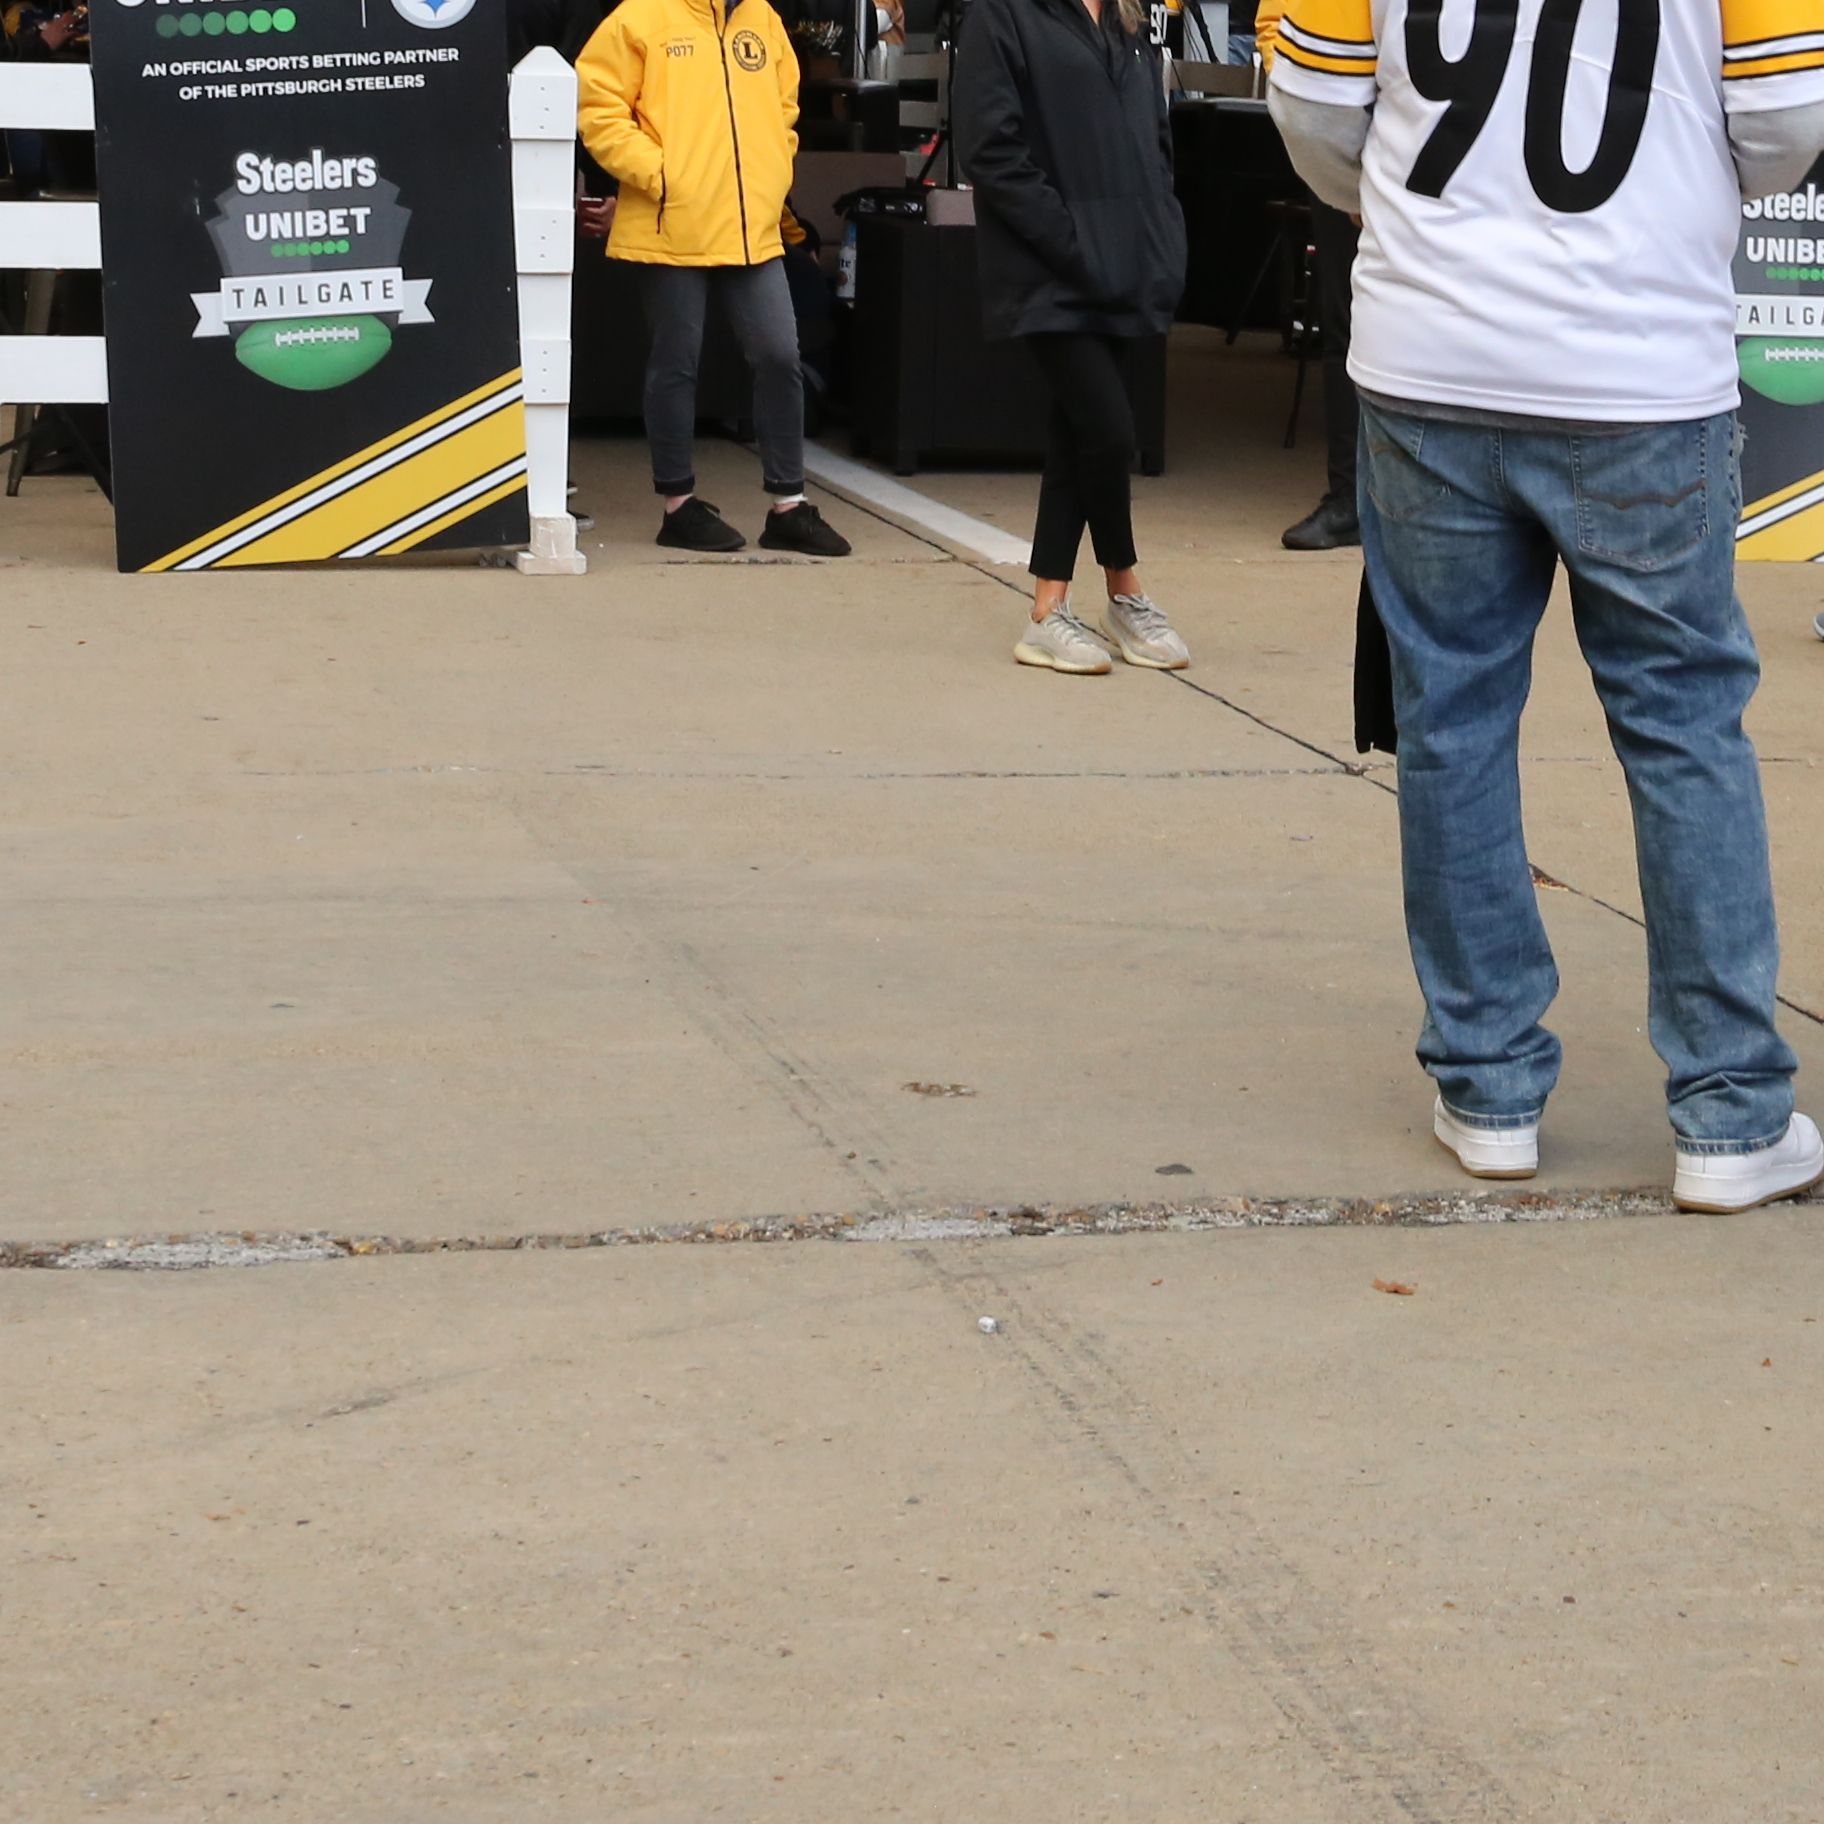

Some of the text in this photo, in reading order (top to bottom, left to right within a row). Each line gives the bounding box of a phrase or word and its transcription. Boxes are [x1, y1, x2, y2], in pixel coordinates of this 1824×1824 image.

[142, 47, 459, 78] AN OFFICIAL SPORTS BETTING PARTNER
[179, 74, 426, 101] OF THE PITTSBURGH STEELERS
[236, 148, 377, 194] Steelers
[245, 206, 372, 241] UNIBET
[232, 278, 394, 309] TAILGATE
